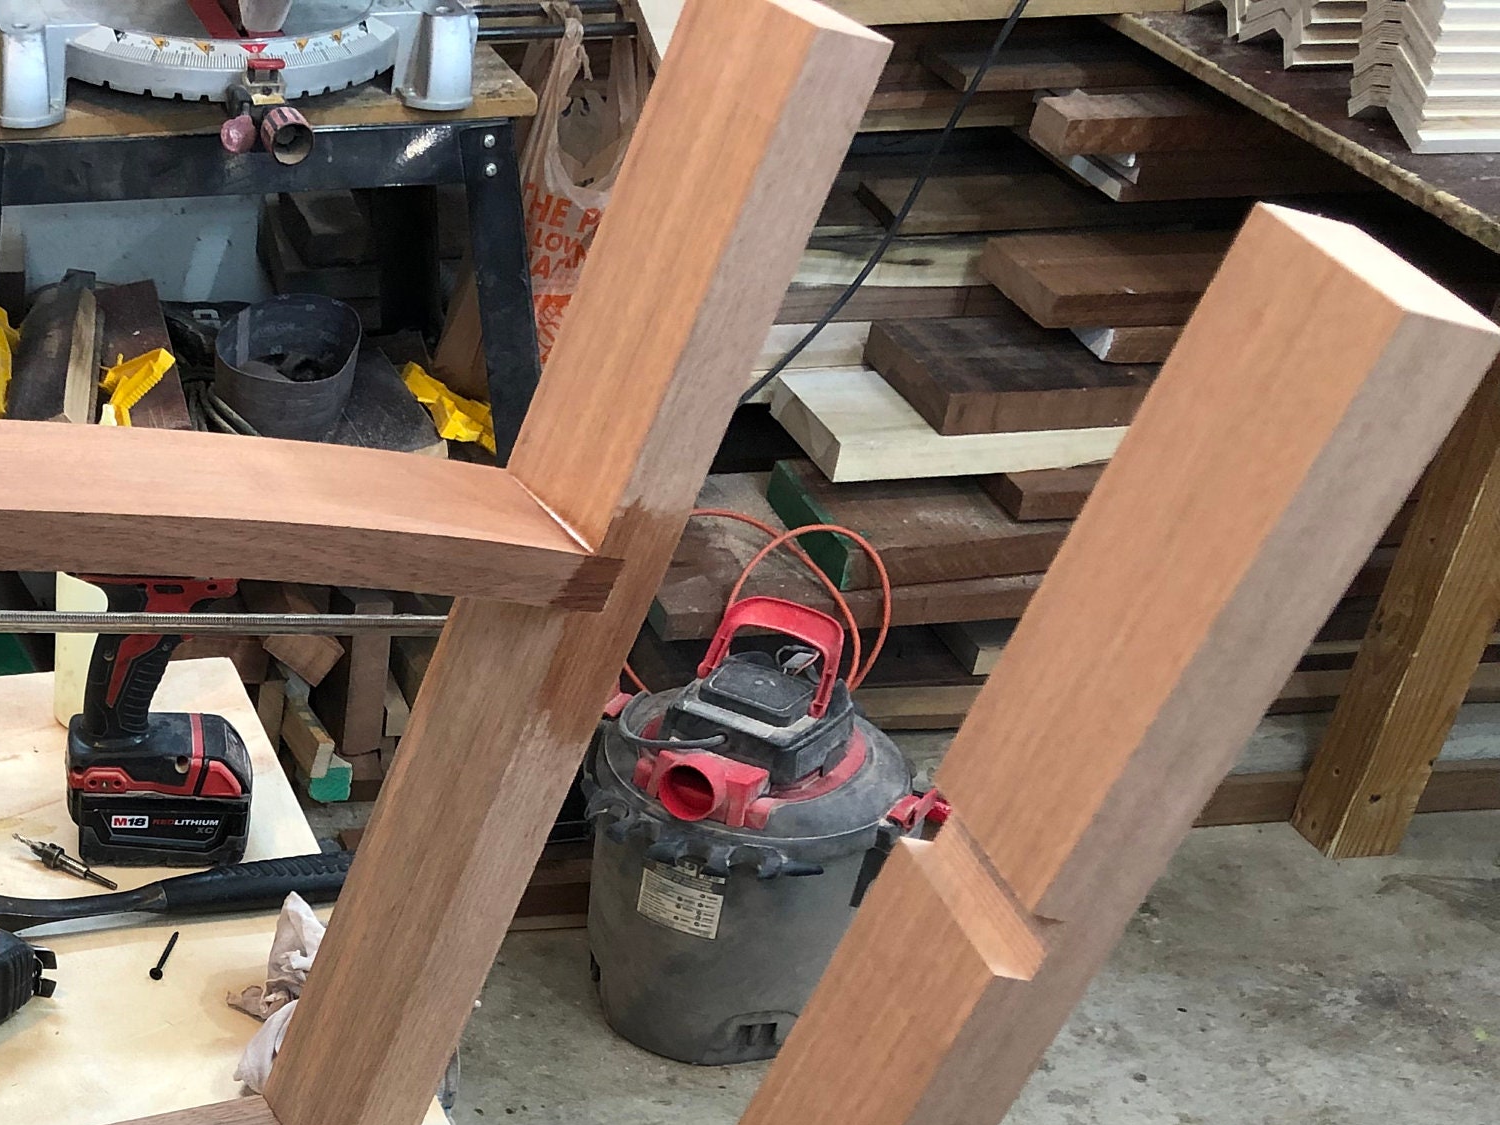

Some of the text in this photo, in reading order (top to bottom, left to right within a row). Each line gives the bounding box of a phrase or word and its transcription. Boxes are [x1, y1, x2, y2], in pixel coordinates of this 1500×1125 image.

[112, 817, 219, 827] M18 REDLITHIUM
[195, 826, 216, 835] XC
